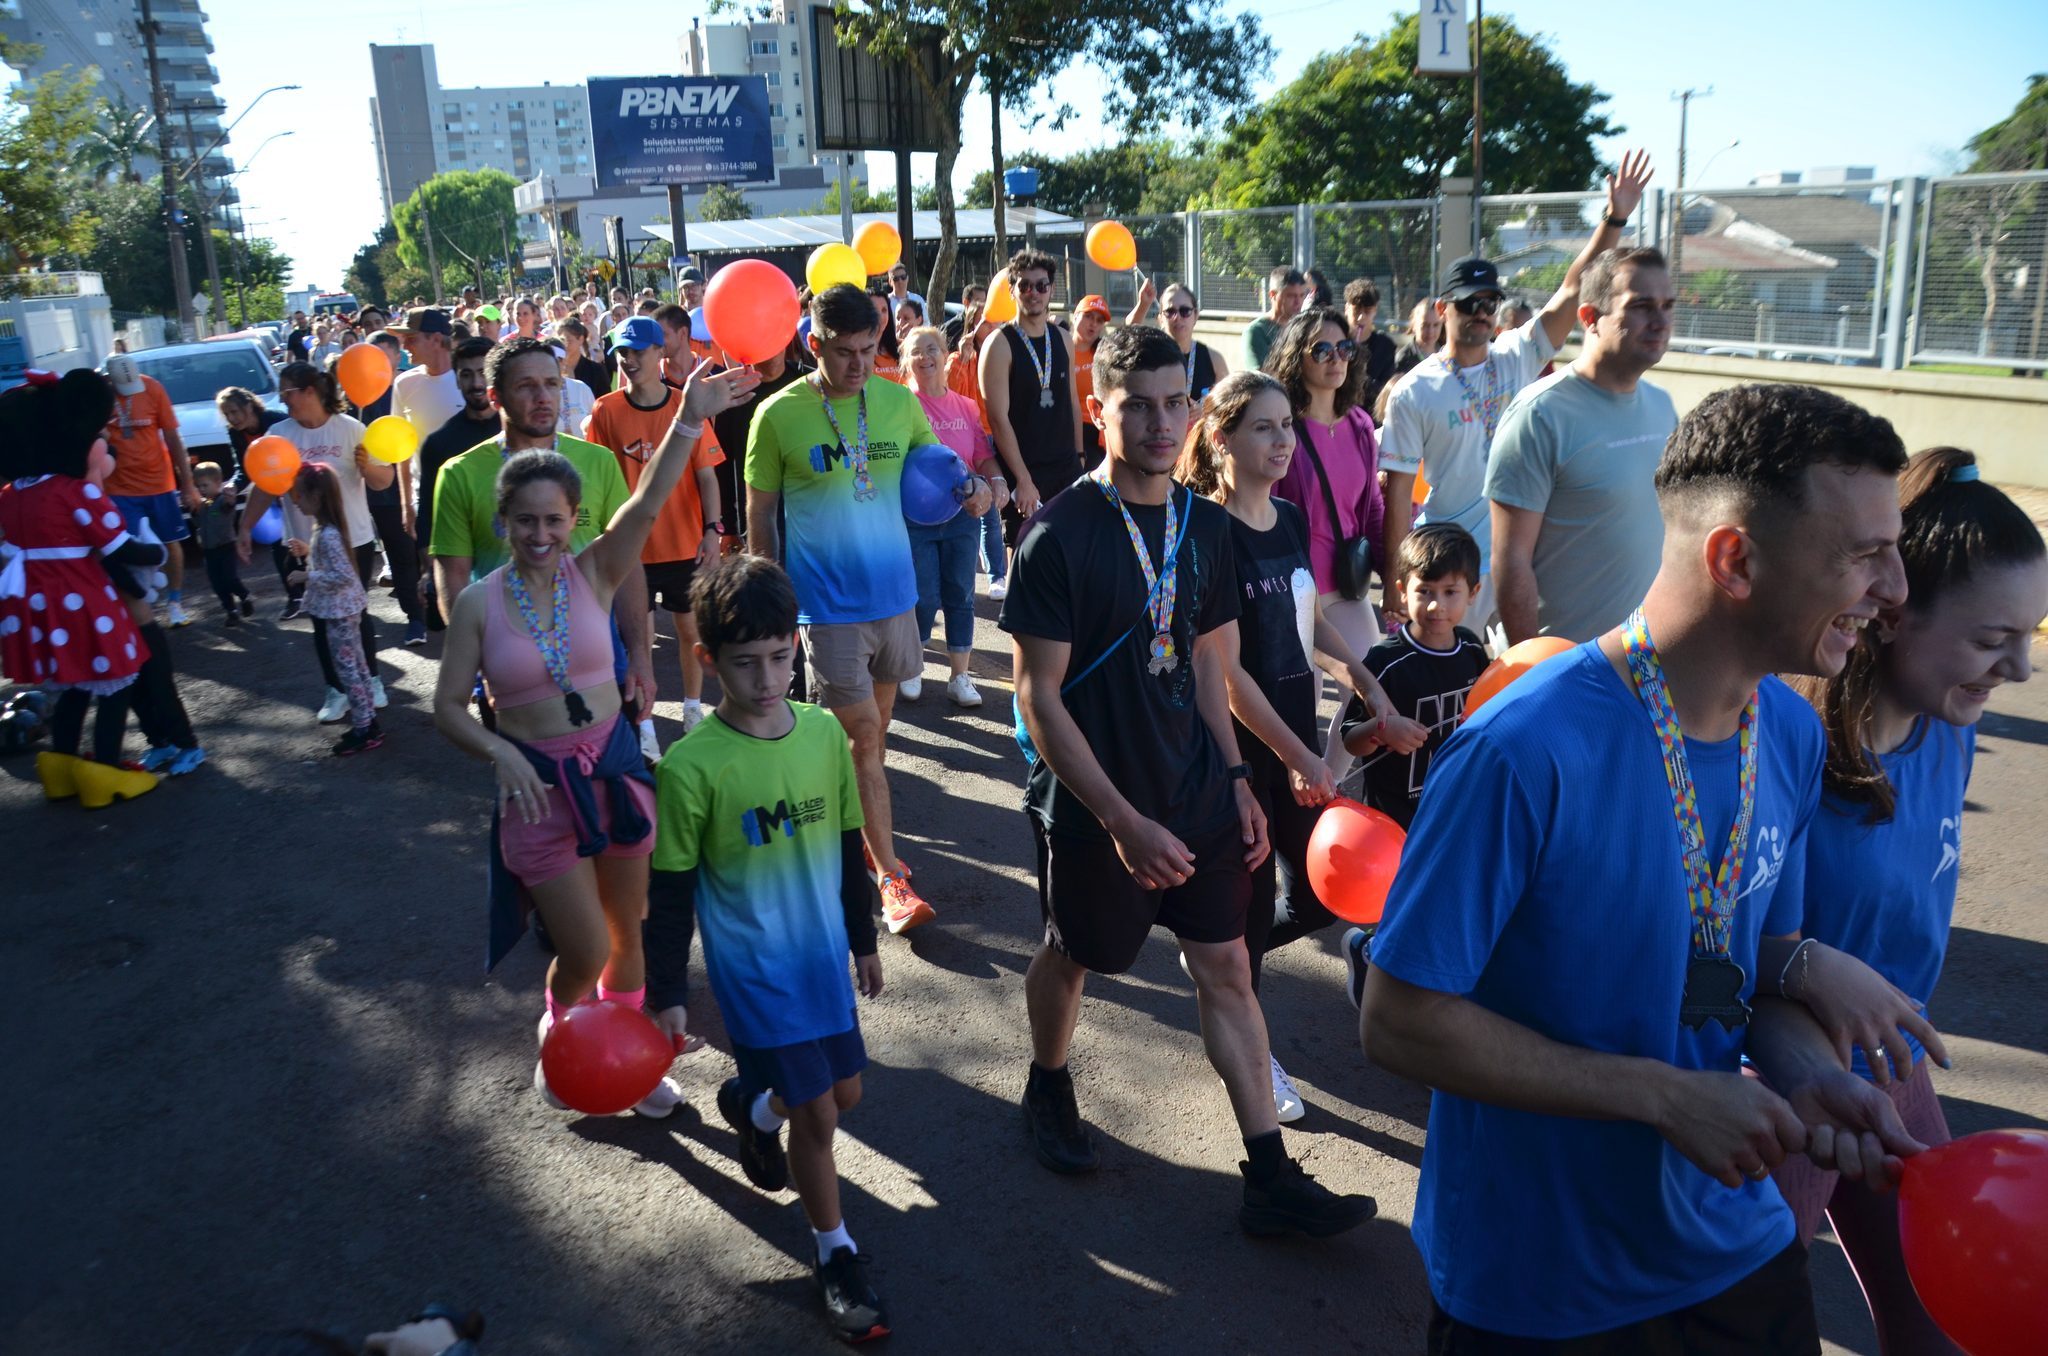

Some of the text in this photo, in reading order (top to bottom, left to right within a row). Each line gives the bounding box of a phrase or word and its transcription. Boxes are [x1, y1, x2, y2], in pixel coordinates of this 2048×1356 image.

[619, 85, 740, 117] PBNEW
[650, 116, 743, 129] SISTEMAS
[643, 136, 724, 147] Soluções tecnológicas
[656, 145, 689, 155] produtos
